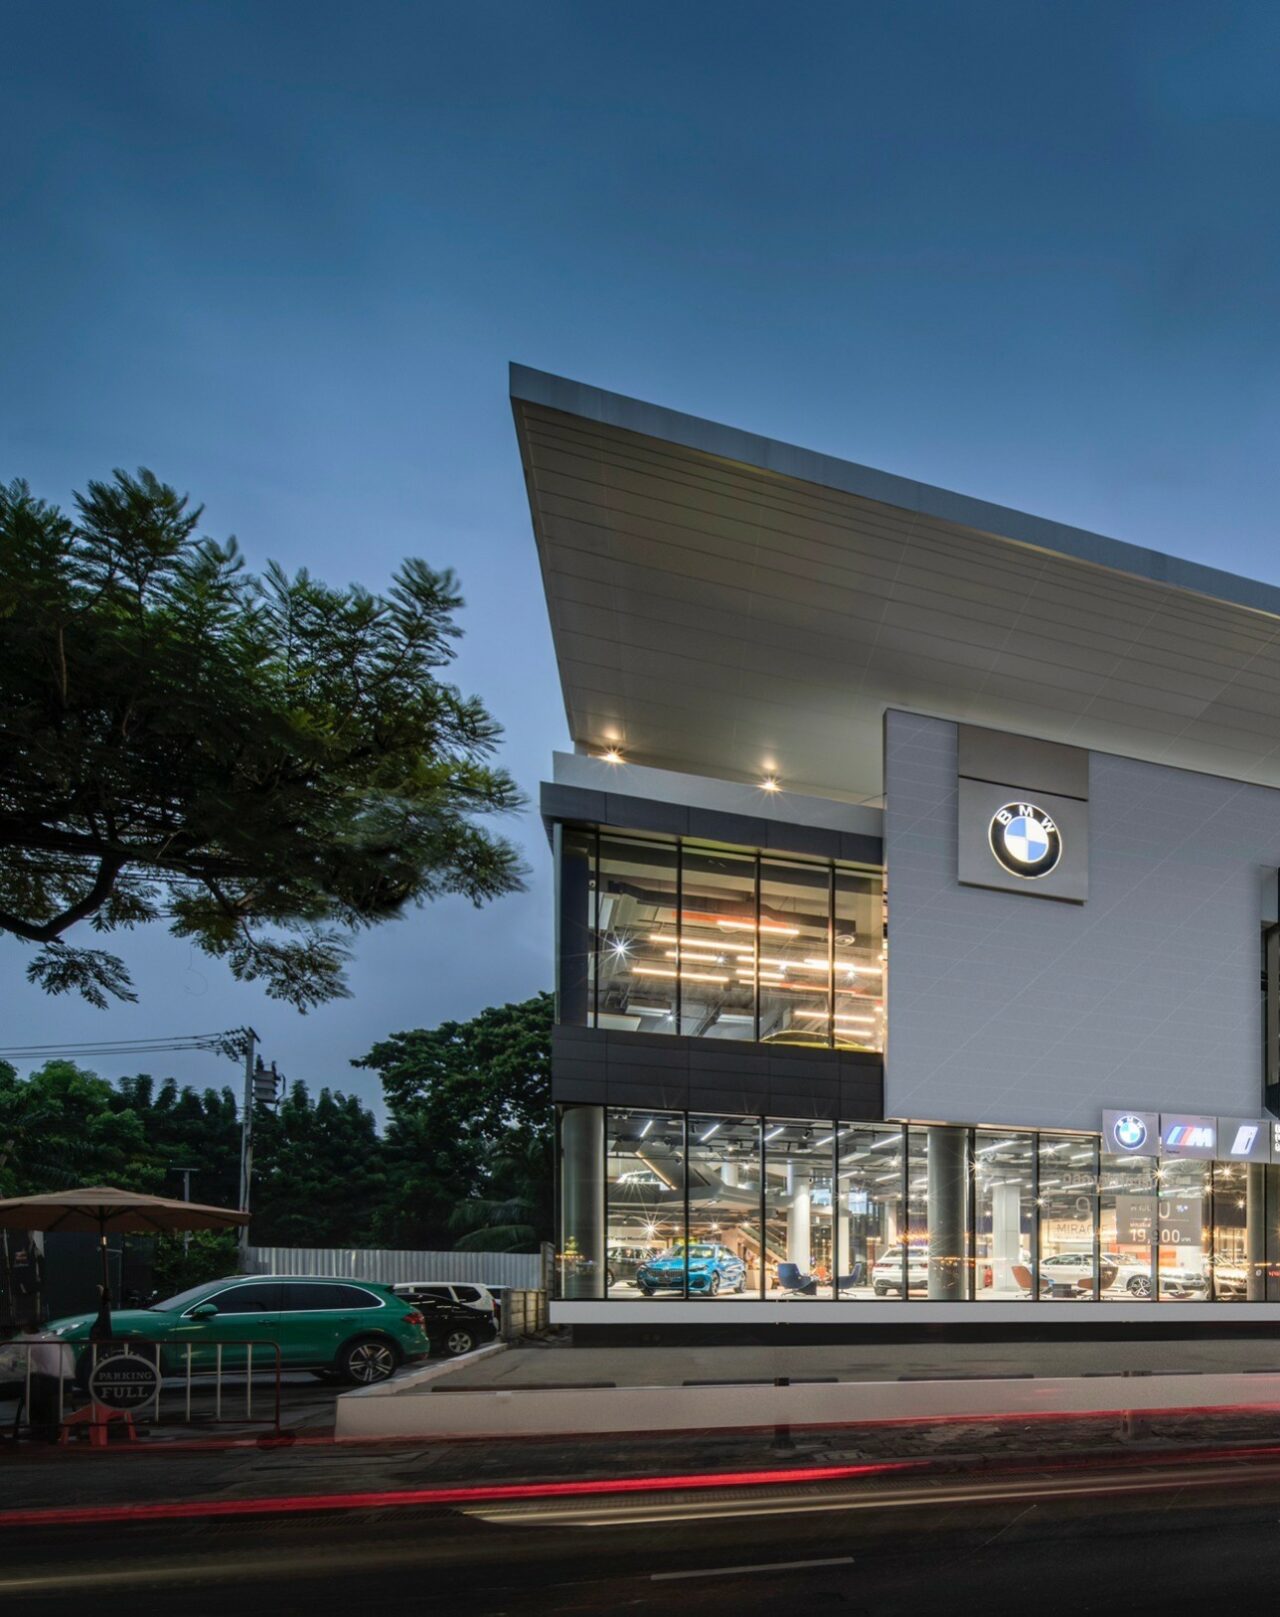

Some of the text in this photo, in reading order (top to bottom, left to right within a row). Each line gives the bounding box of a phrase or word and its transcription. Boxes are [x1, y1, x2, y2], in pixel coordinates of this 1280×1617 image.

[997, 804, 1055, 833] BMW
[1056, 1224, 1109, 1235] MIRACE
[100, 1372, 152, 1380] PARKING
[101, 1387, 148, 1398] FULL
